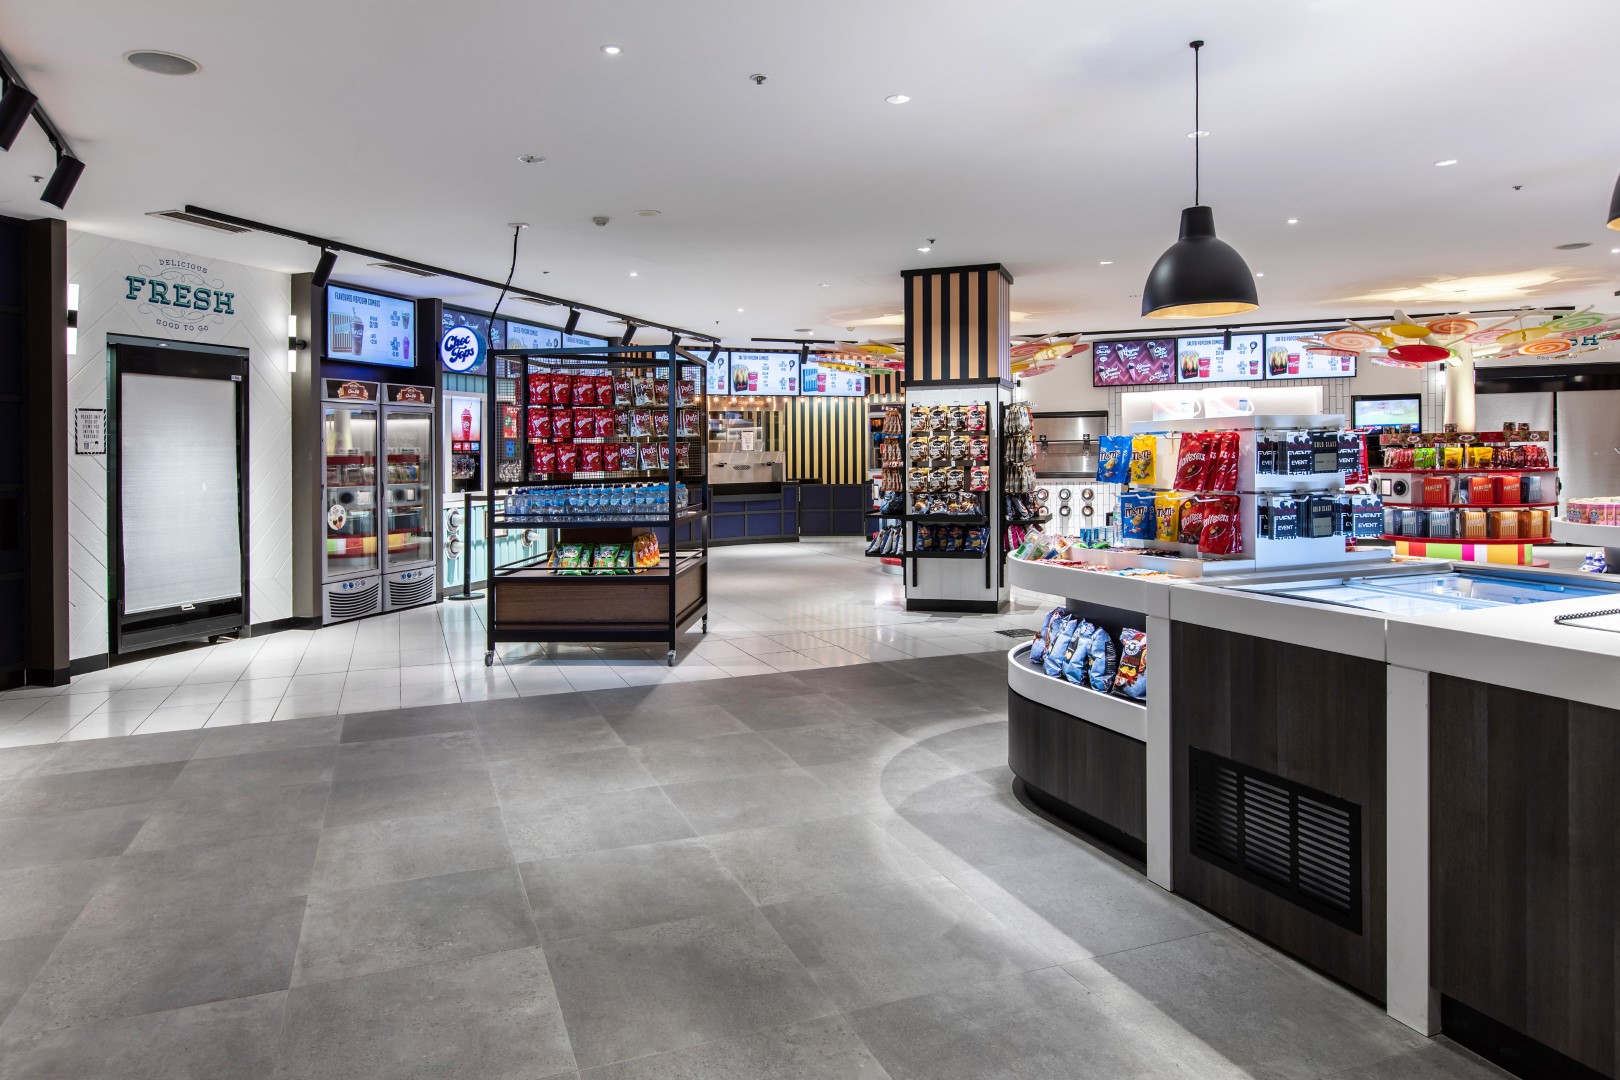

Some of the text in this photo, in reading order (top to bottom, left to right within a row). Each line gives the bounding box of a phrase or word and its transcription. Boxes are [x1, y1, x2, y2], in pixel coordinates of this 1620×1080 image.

[159, 259, 208, 274] DELICIOUS
[125, 275, 235, 315] FRESH
[334, 291, 381, 308] FLAVOURED POPCORN COMBOS
[156, 319, 180, 330] GOOD
[444, 335, 471, 352] Choc
[449, 346, 475, 363] Tops
[615, 382, 630, 391] Pods
[654, 384, 669, 393] Pods
[680, 385, 694, 393] Pods
[636, 413, 650, 423] Pods
[654, 414, 669, 423] Pods
[685, 414, 699, 423] Pods
[620, 446, 636, 456] Pods
[642, 446, 656, 456] Pods
[1425, 483, 1442, 491] PARLOUR
[1473, 483, 1492, 491] PARLOUR
[1503, 483, 1520, 491] PARLOUR
